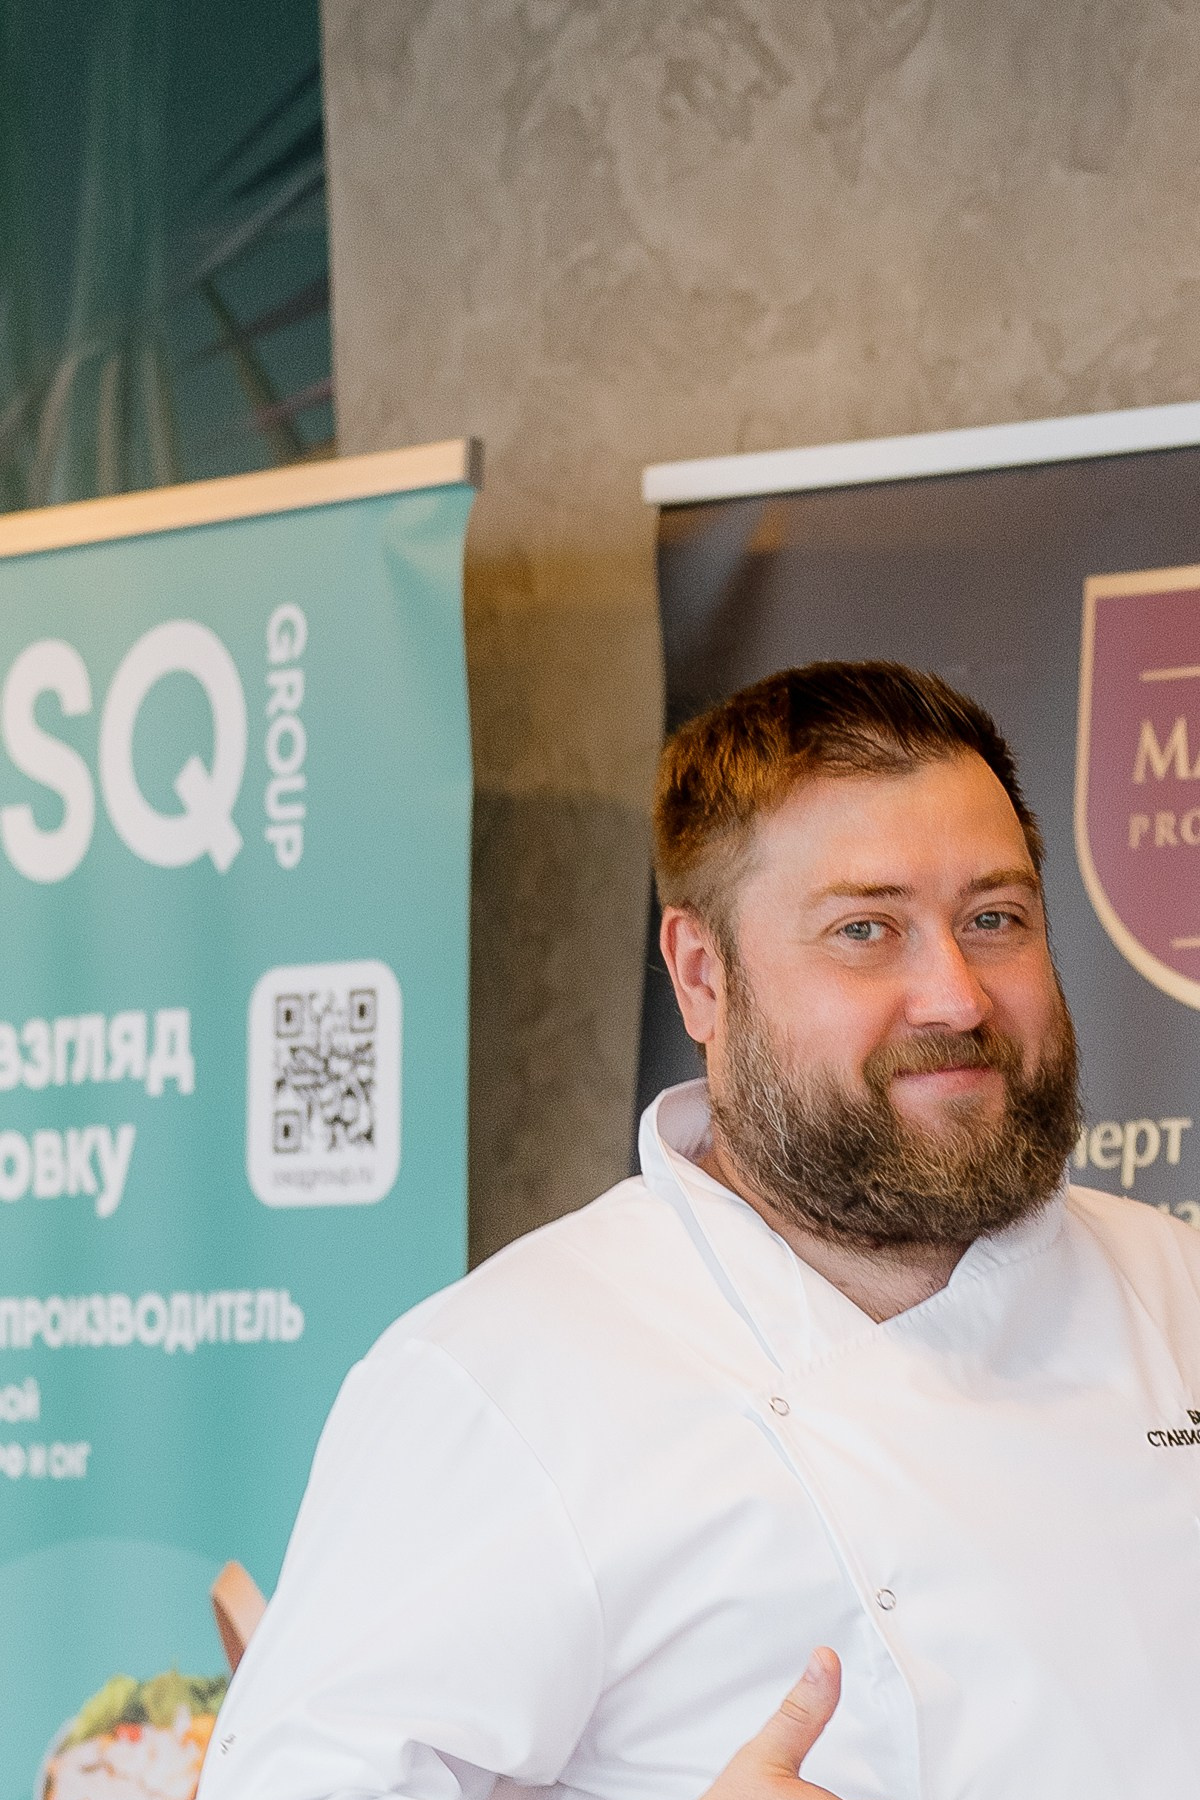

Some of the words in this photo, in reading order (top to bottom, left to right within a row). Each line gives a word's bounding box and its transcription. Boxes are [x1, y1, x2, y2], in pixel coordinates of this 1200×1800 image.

[1, 619, 248, 883] SQ
[264, 602, 309, 870] GROUP
[0, 1289, 305, 1354] ПРОИЗВОДИТЕЛЬ
